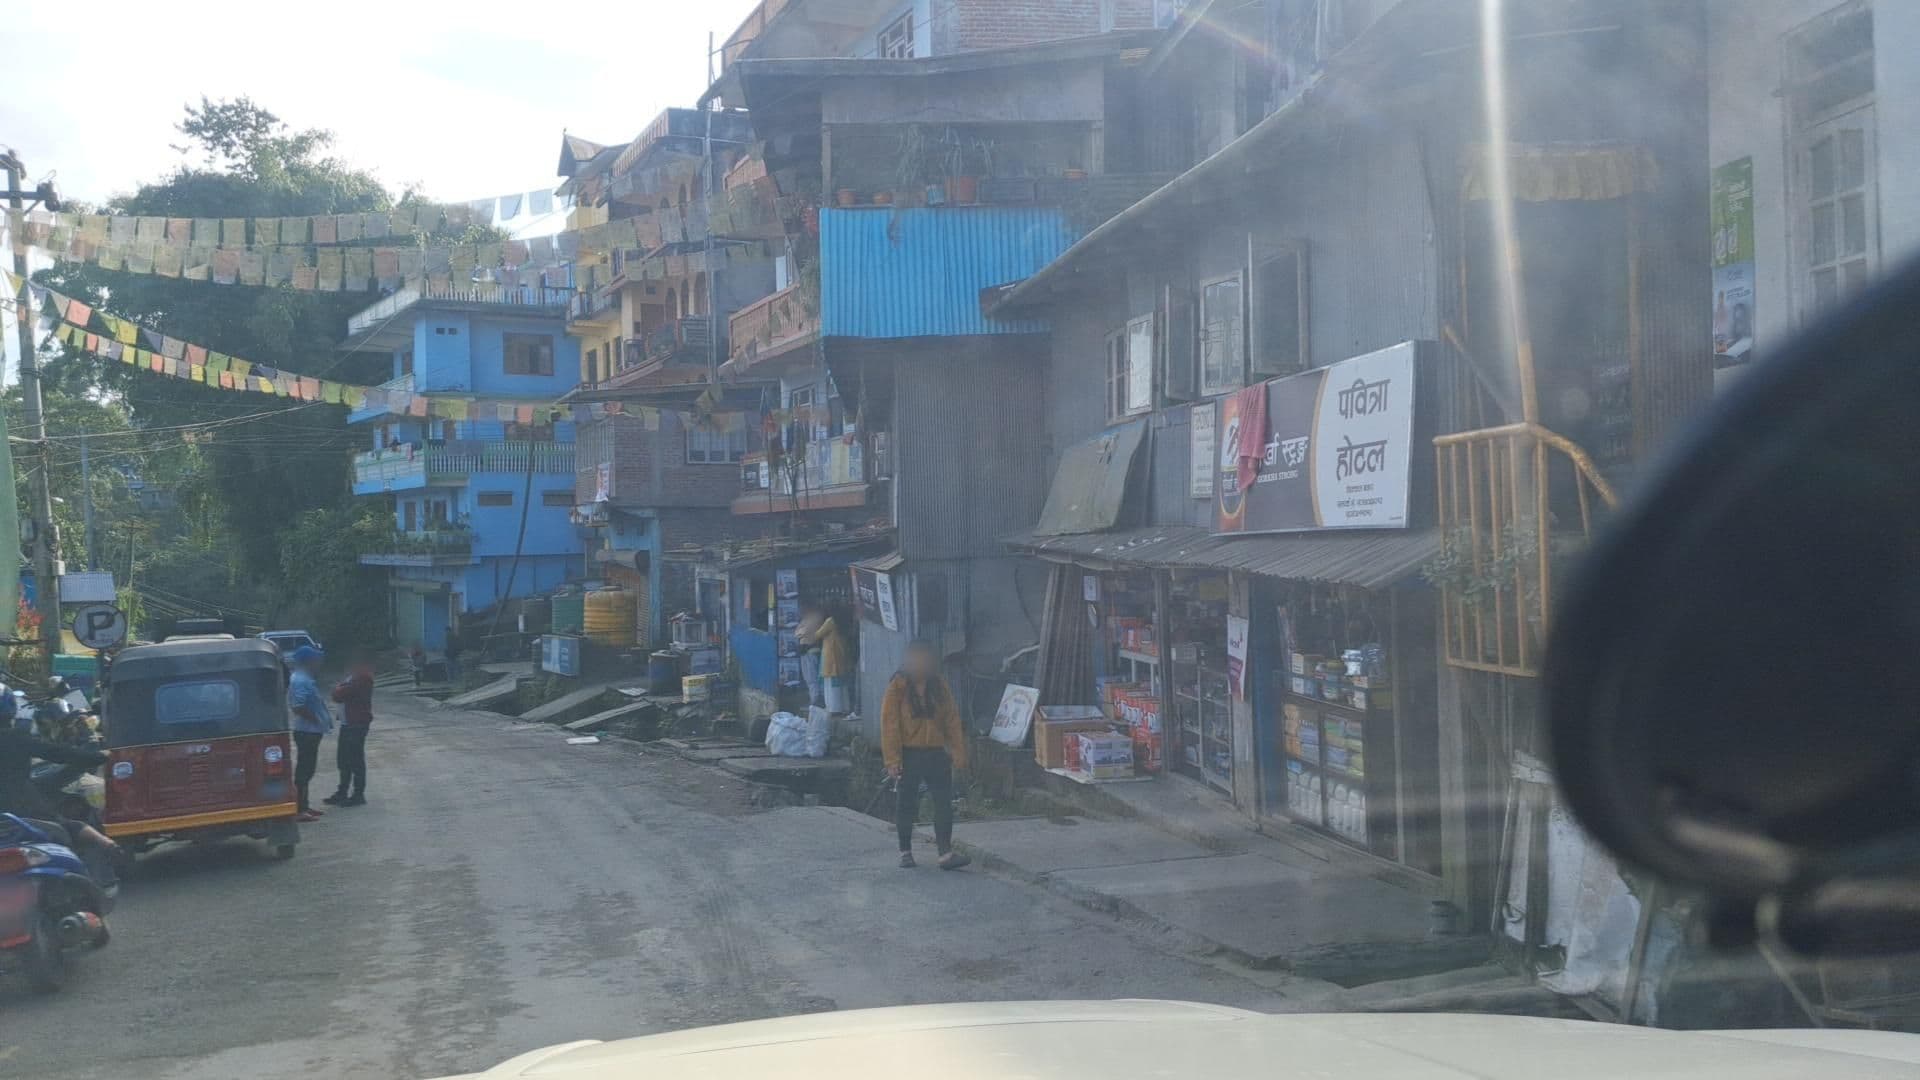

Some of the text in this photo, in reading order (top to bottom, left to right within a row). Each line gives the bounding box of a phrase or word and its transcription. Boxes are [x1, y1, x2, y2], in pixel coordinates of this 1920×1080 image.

[1338, 377, 1391, 419] पवित्रा
[1336, 434, 1388, 481] होटल
[87, 610, 115, 641] P
